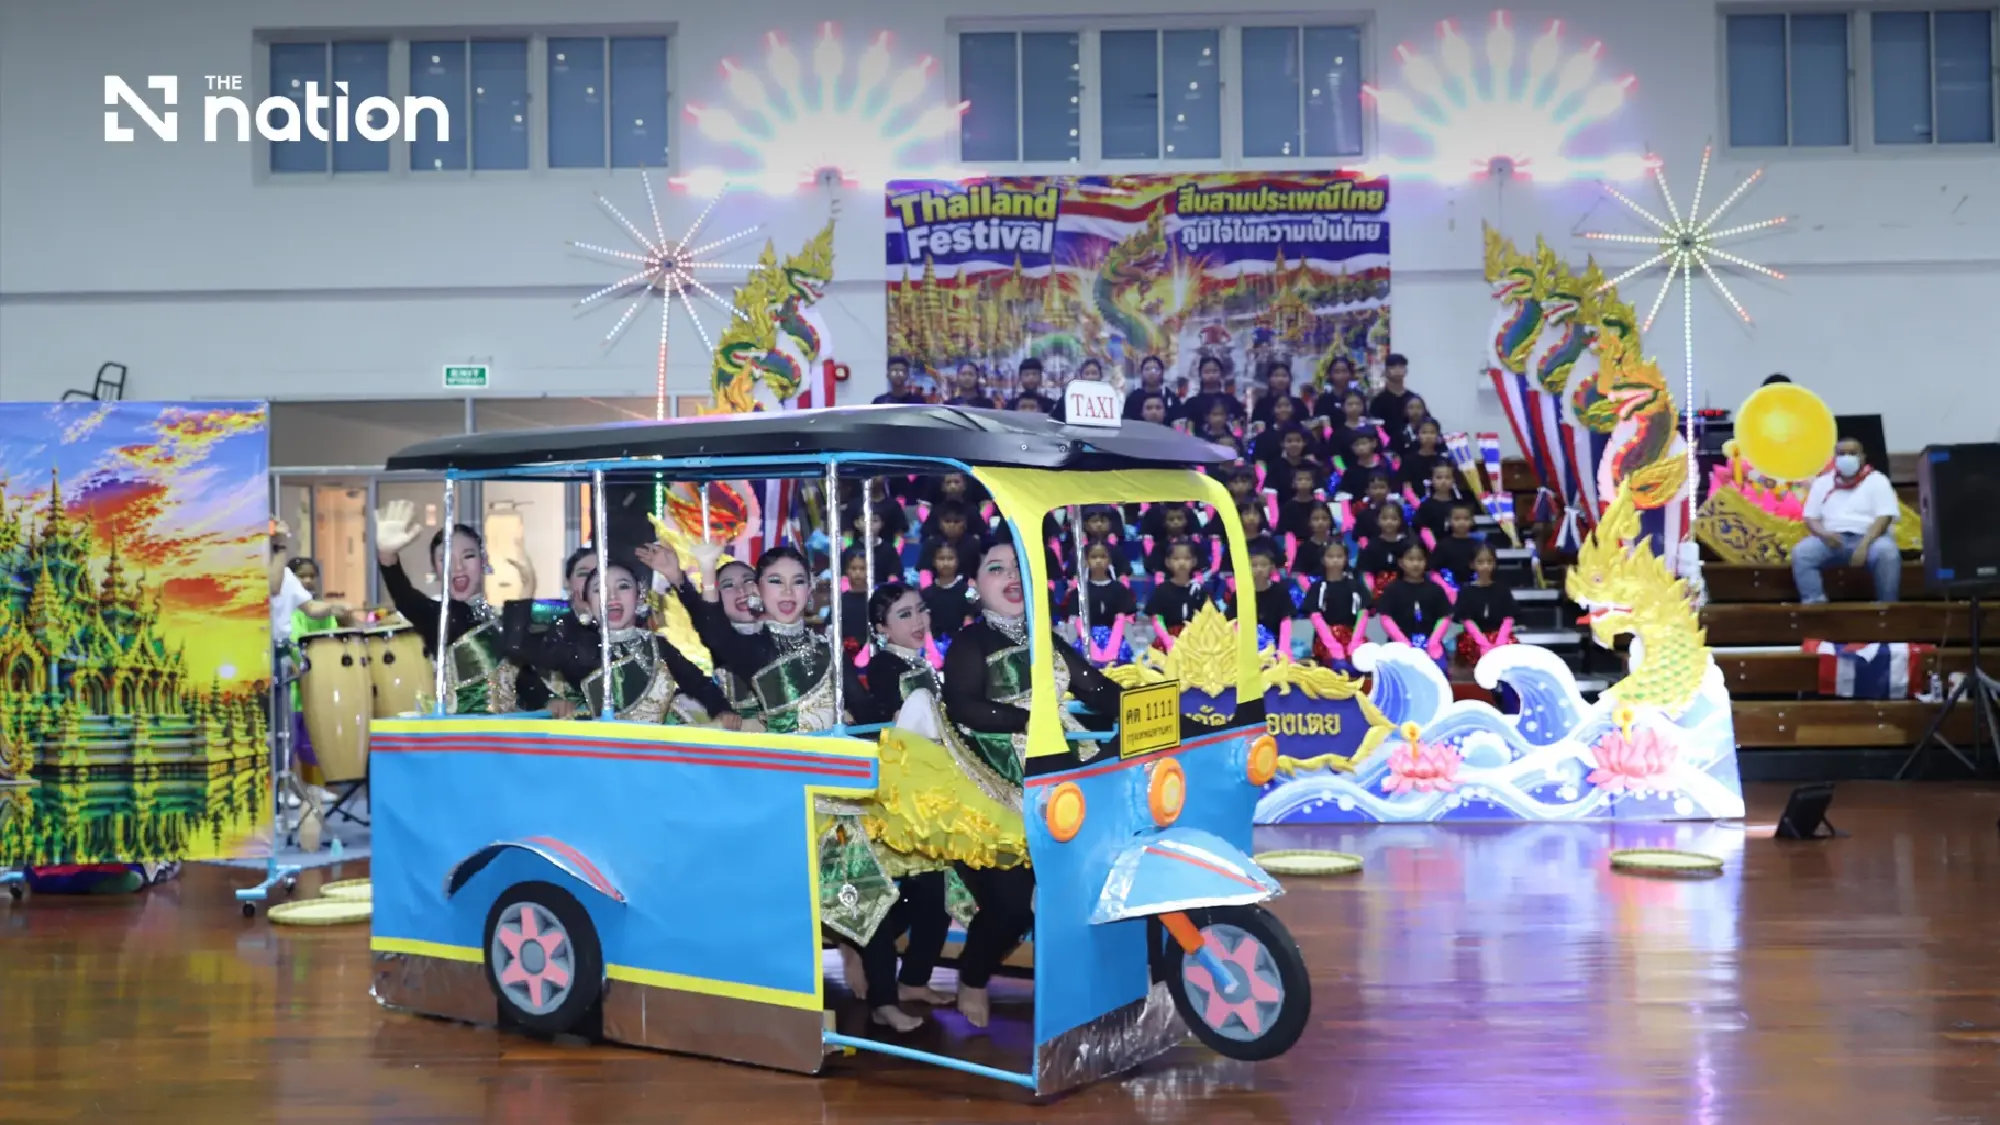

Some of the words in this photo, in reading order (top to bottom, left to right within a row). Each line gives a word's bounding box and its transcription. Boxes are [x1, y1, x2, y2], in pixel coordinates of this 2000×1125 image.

[891, 185, 1059, 227] Thailand
[1177, 181, 1385, 213] สืบสานประเพณีไทย
[907, 217, 1055, 260] Festival
[1180, 216, 1381, 250] ภูมิใจในความเป็นไทย
[1070, 393, 1115, 420] TAXI
[1146, 699, 1174, 721] 1111
